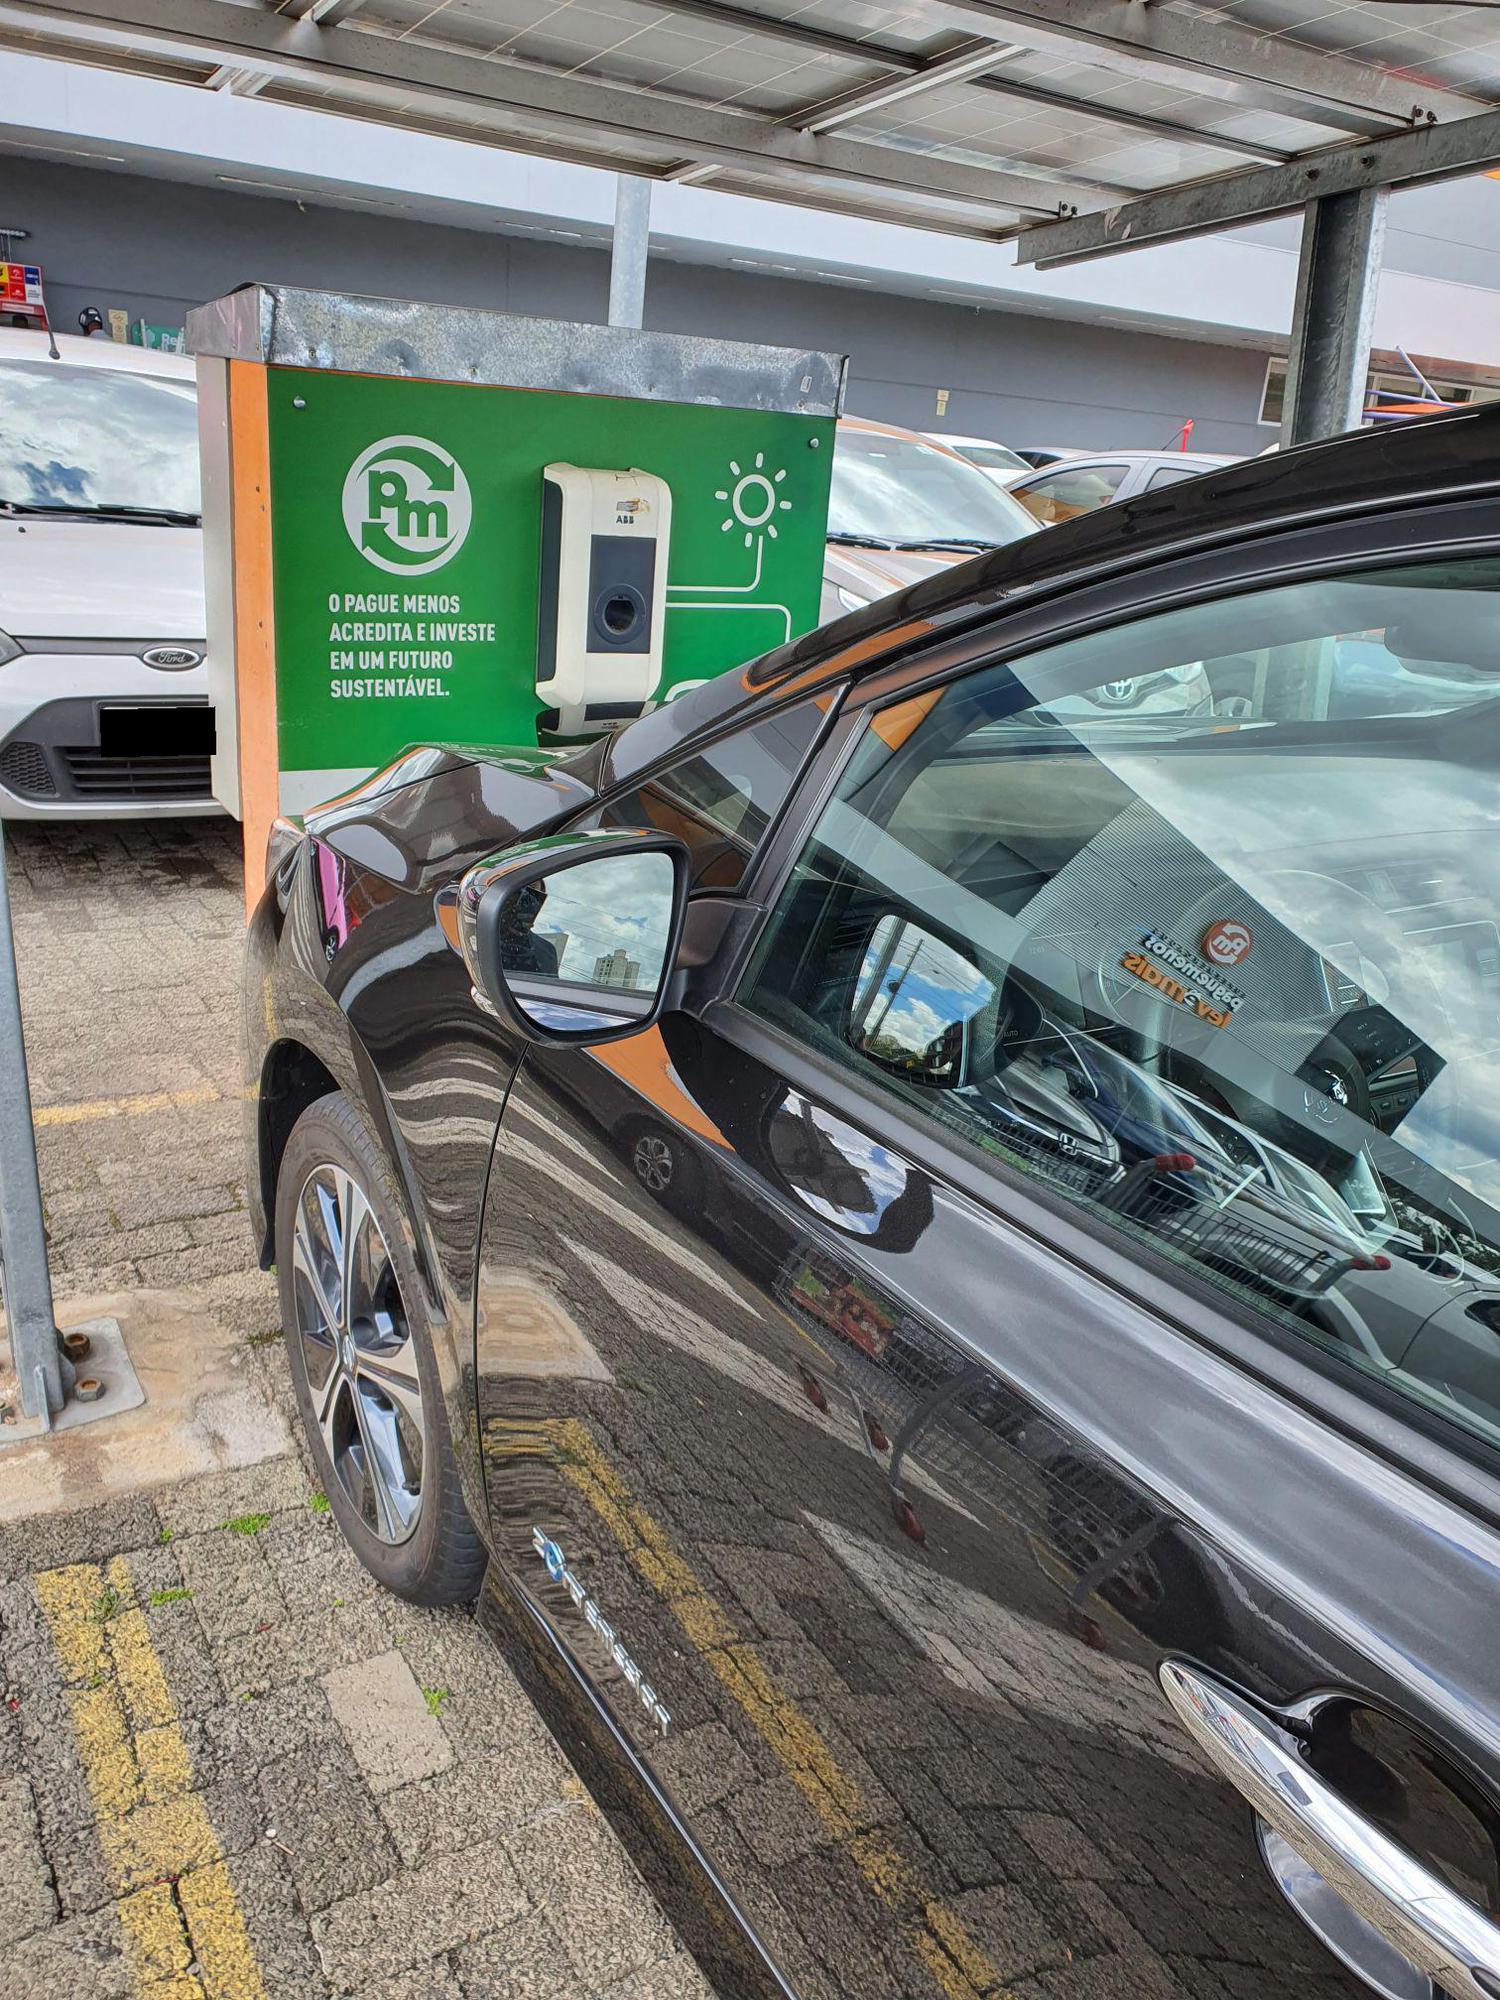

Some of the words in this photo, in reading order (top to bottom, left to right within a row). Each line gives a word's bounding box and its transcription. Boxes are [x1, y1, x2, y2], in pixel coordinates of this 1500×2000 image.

[616, 515, 634, 524] ABB
[328, 594, 340, 613] O
[344, 594, 399, 613] PAGUE
[403, 595, 460, 614] MENOS
[329, 623, 413, 642] ACREDITA
[417, 623, 426, 641] E
[430, 623, 496, 641] INVESTE
[330, 651, 353, 670] EM
[359, 651, 384, 669] UM
[389, 651, 452, 669] FUTURO
[330, 674, 450, 698] SUSTENTÁVEL.
